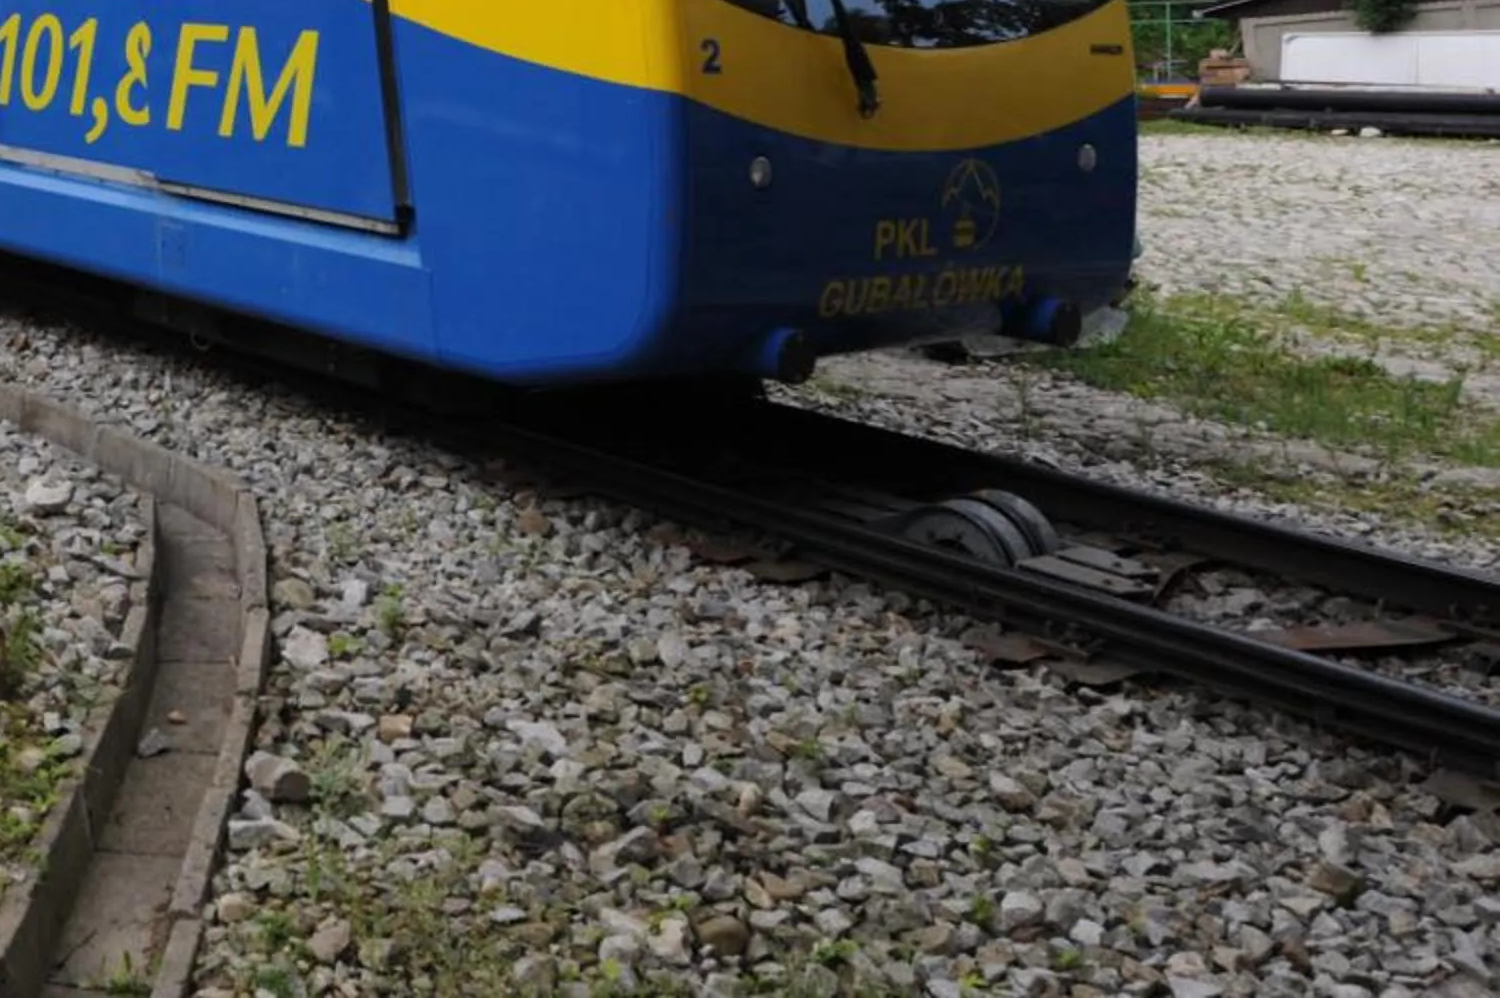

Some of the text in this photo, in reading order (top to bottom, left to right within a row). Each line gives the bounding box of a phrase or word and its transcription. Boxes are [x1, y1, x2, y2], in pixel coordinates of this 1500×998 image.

[702, 39, 722, 74] 2
[166, 22, 320, 148] FM
[873, 218, 939, 261] PKL
